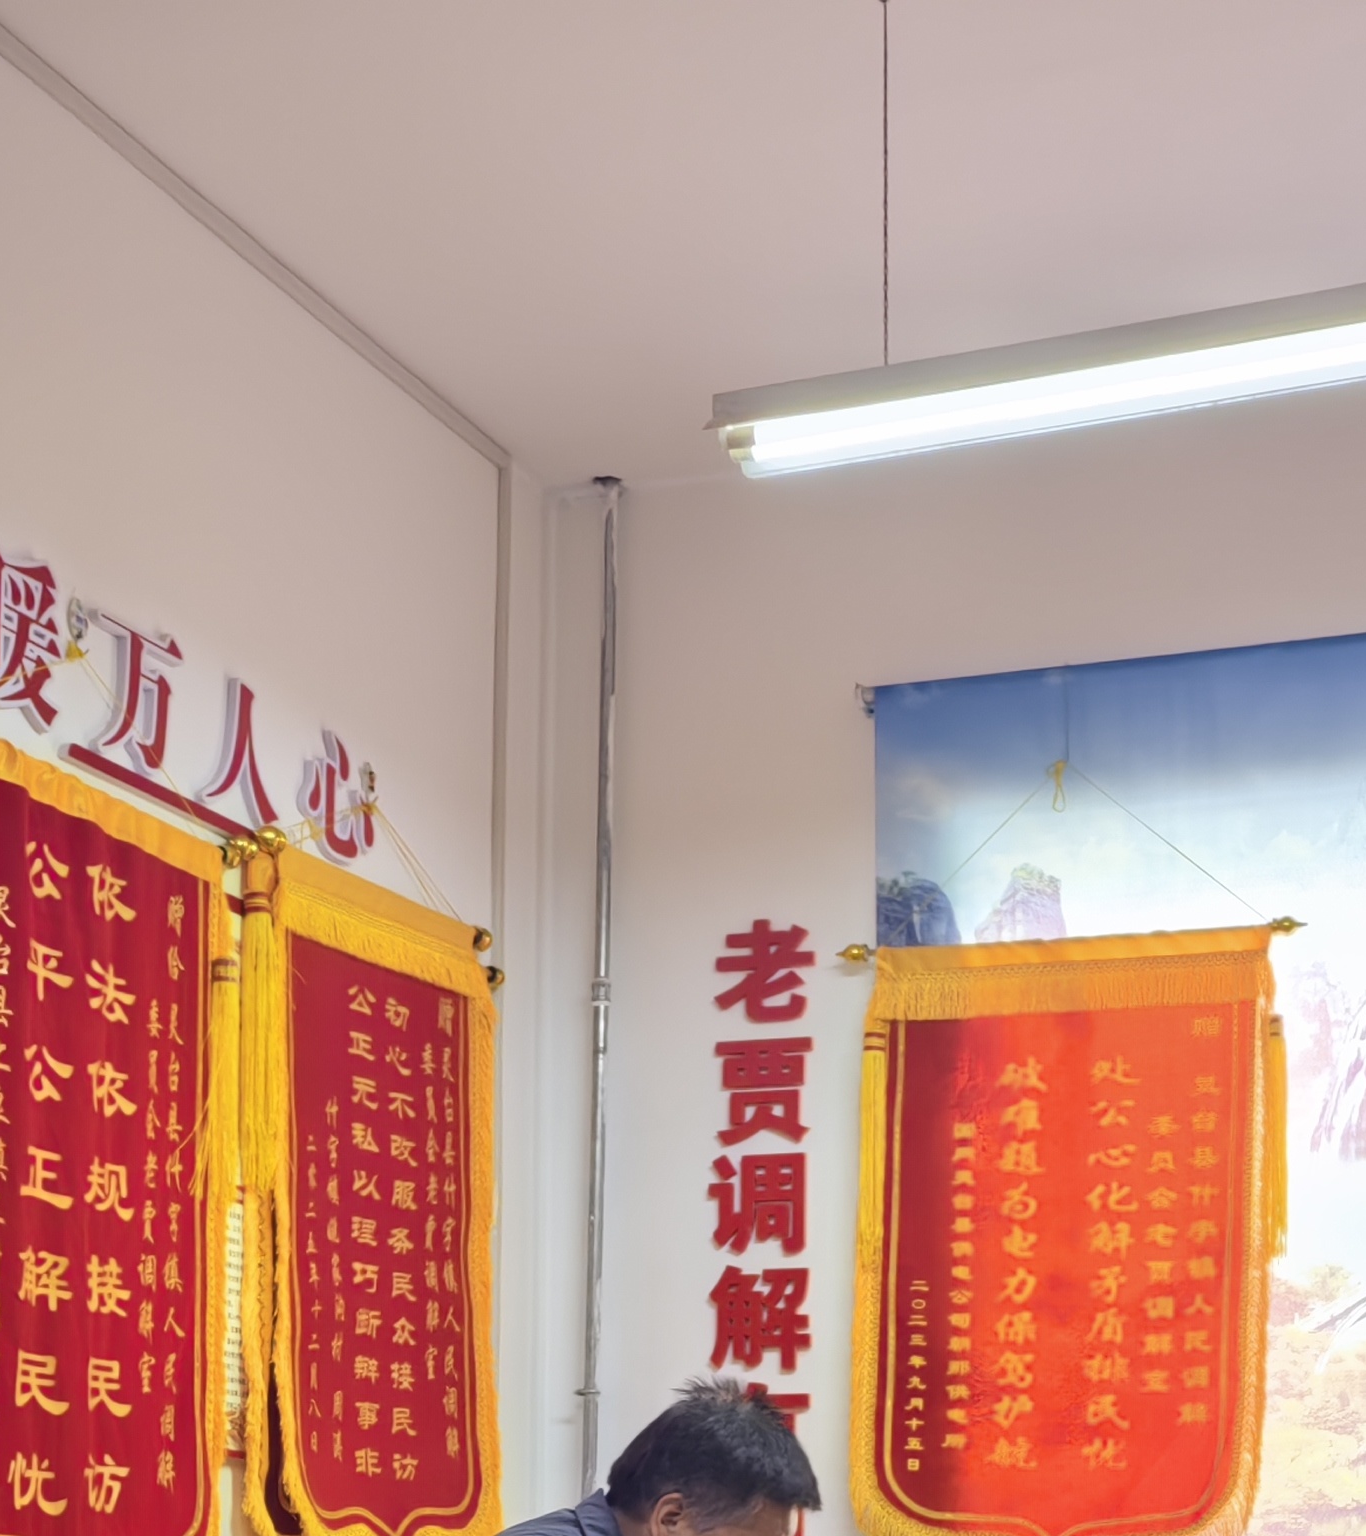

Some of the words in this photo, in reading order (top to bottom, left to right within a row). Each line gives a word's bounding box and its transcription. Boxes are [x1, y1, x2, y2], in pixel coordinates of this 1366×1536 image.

[7, 841, 76, 1517] 公平公正解民忧
[83, 864, 138, 1515] 依法依规接民访
